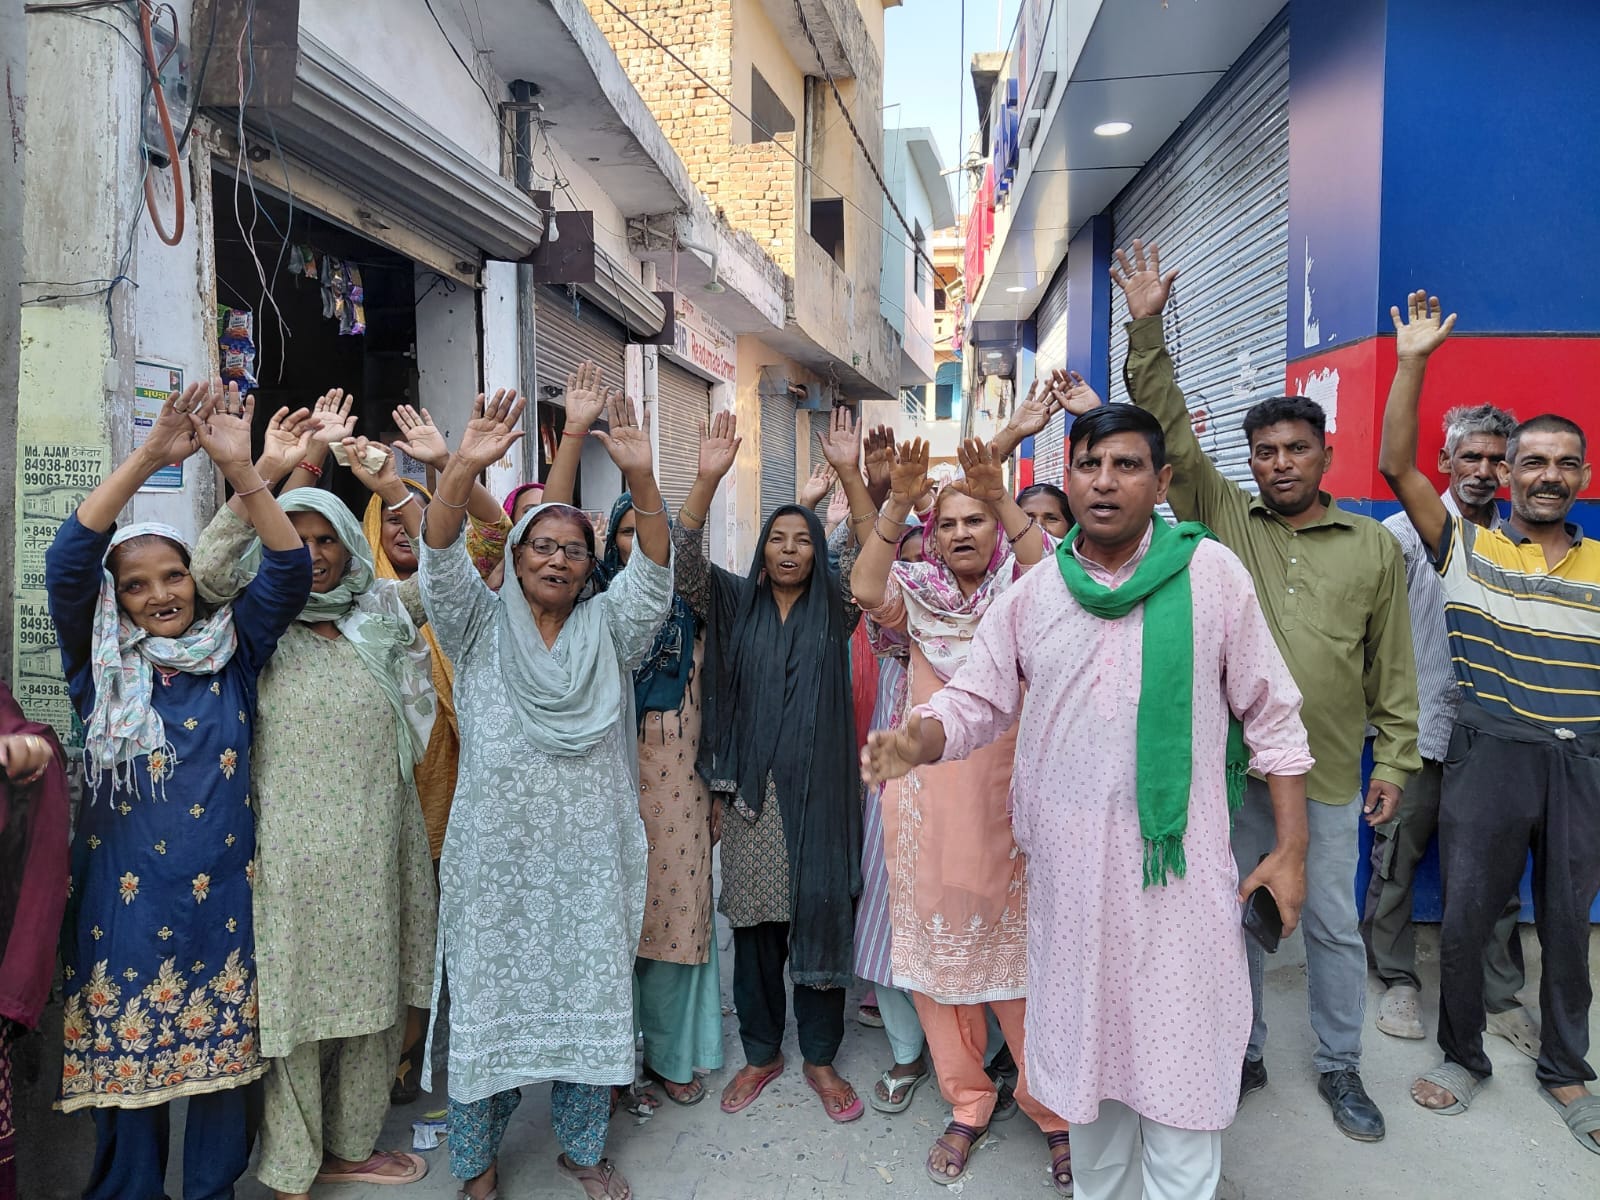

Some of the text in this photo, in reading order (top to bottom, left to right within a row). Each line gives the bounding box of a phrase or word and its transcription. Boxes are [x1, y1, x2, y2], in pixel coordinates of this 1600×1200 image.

[25, 446, 41, 457] Md.
[44, 446, 70, 458] AJAM
[24, 458, 102, 473] 84938-80377
[24, 472, 102, 487] 99063-75930
[33, 526, 58, 537] 8493
[24, 573, 45, 584] 990
[20, 605, 36, 616] Md.
[20, 617, 56, 631] 84938
[20, 631, 56, 645] 99063
[28, 684, 69, 696] 84938-8
